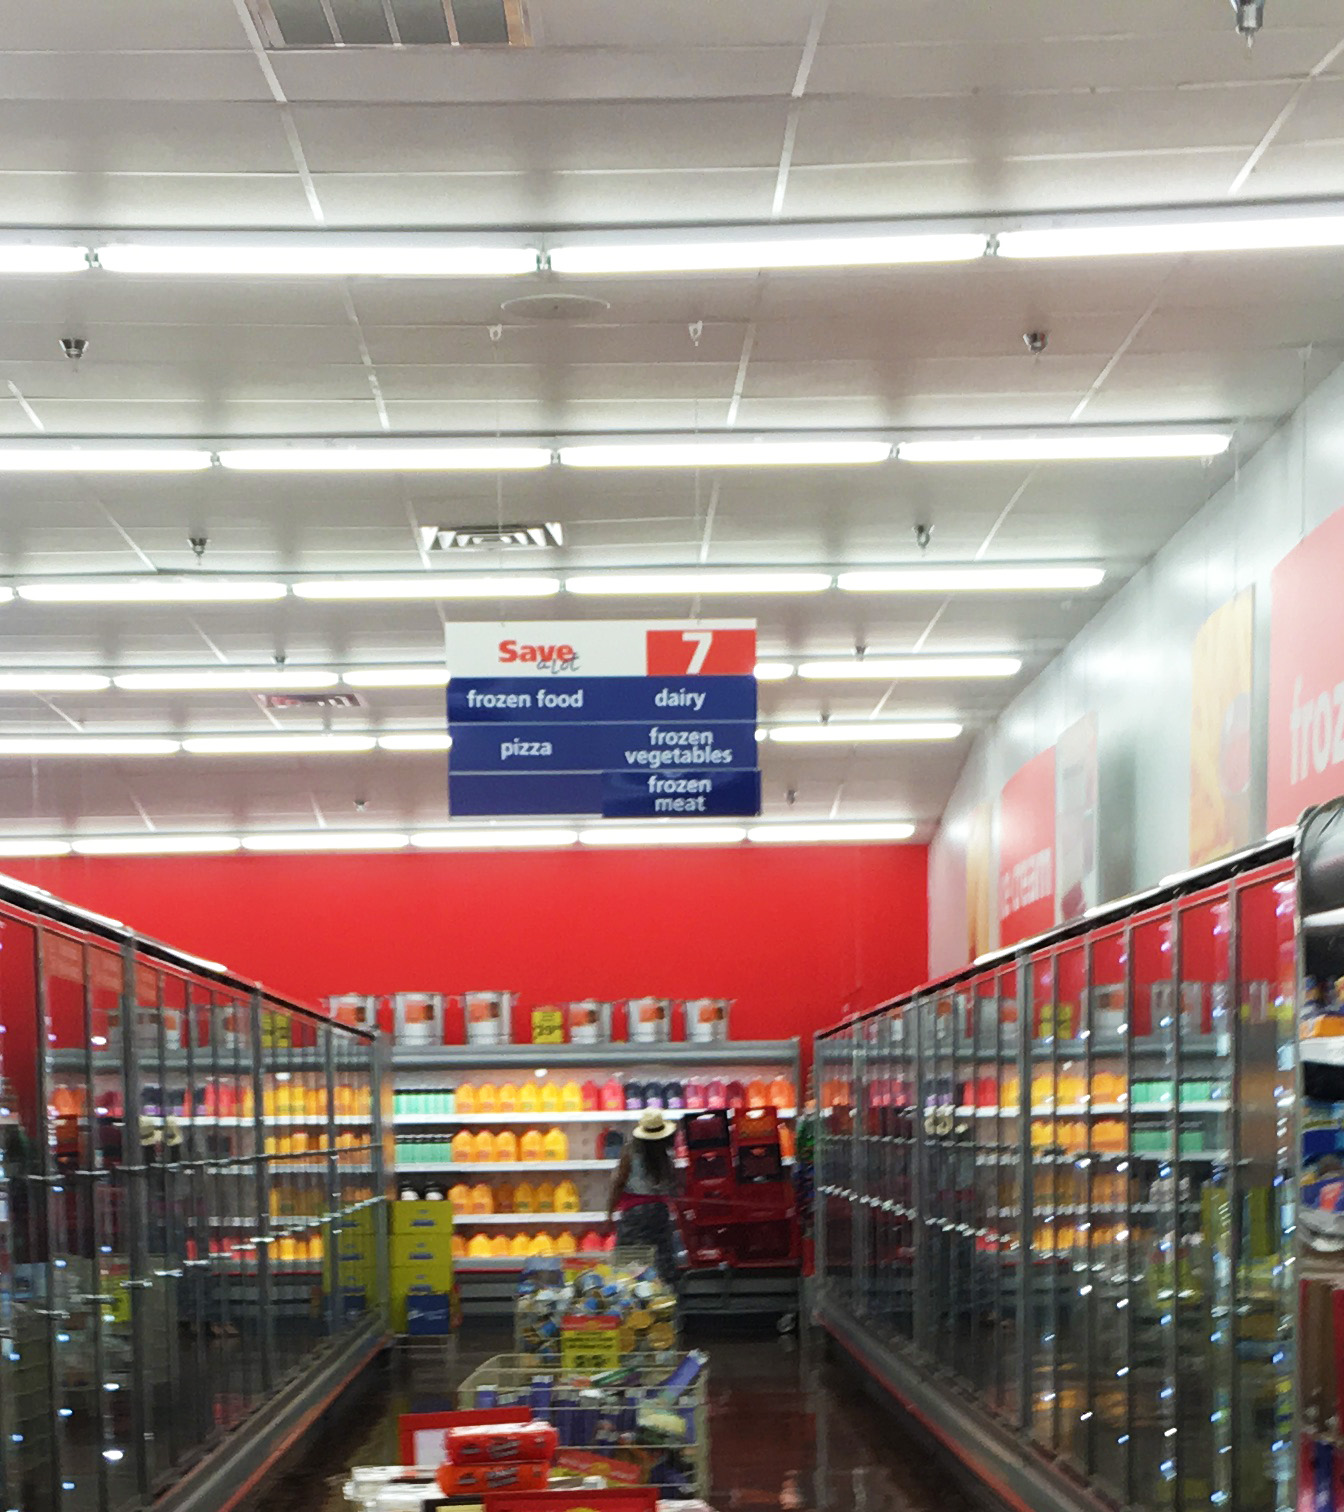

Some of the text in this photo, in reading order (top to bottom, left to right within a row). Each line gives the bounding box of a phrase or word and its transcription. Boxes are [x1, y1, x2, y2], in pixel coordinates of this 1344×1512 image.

[498, 640, 575, 663] Save
[681, 631, 713, 675] 7
[466, 689, 584, 708] frozen food
[655, 688, 706, 711] dairy
[649, 727, 714, 746] frozen
[500, 737, 553, 760] pizza
[623, 746, 733, 768] vegetables
[648, 776, 712, 794] frozen
[655, 795, 706, 812] meat
